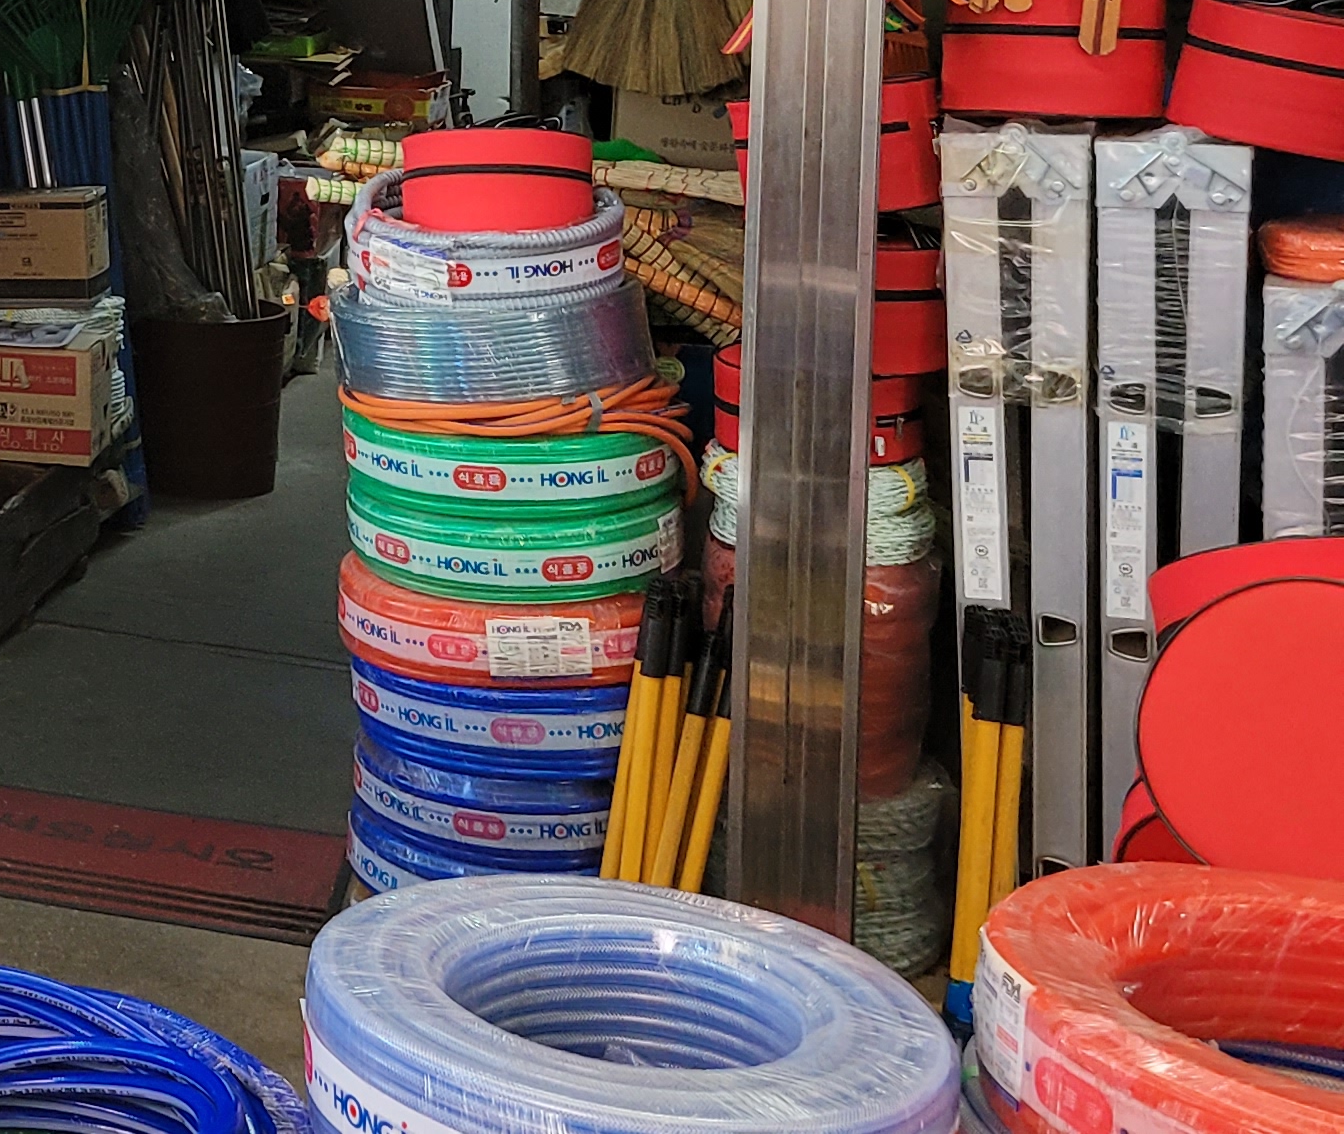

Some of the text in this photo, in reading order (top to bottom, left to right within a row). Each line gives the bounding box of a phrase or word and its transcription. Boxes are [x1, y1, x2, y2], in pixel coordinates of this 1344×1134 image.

[524, 259, 574, 279] HONG
[372, 452, 409, 475] HONG
[540, 471, 593, 488] HONG
[437, 556, 490, 576] HONG
[622, 546, 658, 569] HONG
[357, 616, 388, 641] HONG
[492, 624, 521, 634] HONG
[559, 622, 583, 632] FDA
[398, 706, 441, 731] HONG
[374, 786, 409, 814] HONG
[540, 823, 591, 840] HONG
[361, 856, 388, 884] HONG
[1002, 971, 1022, 1004] FDA
